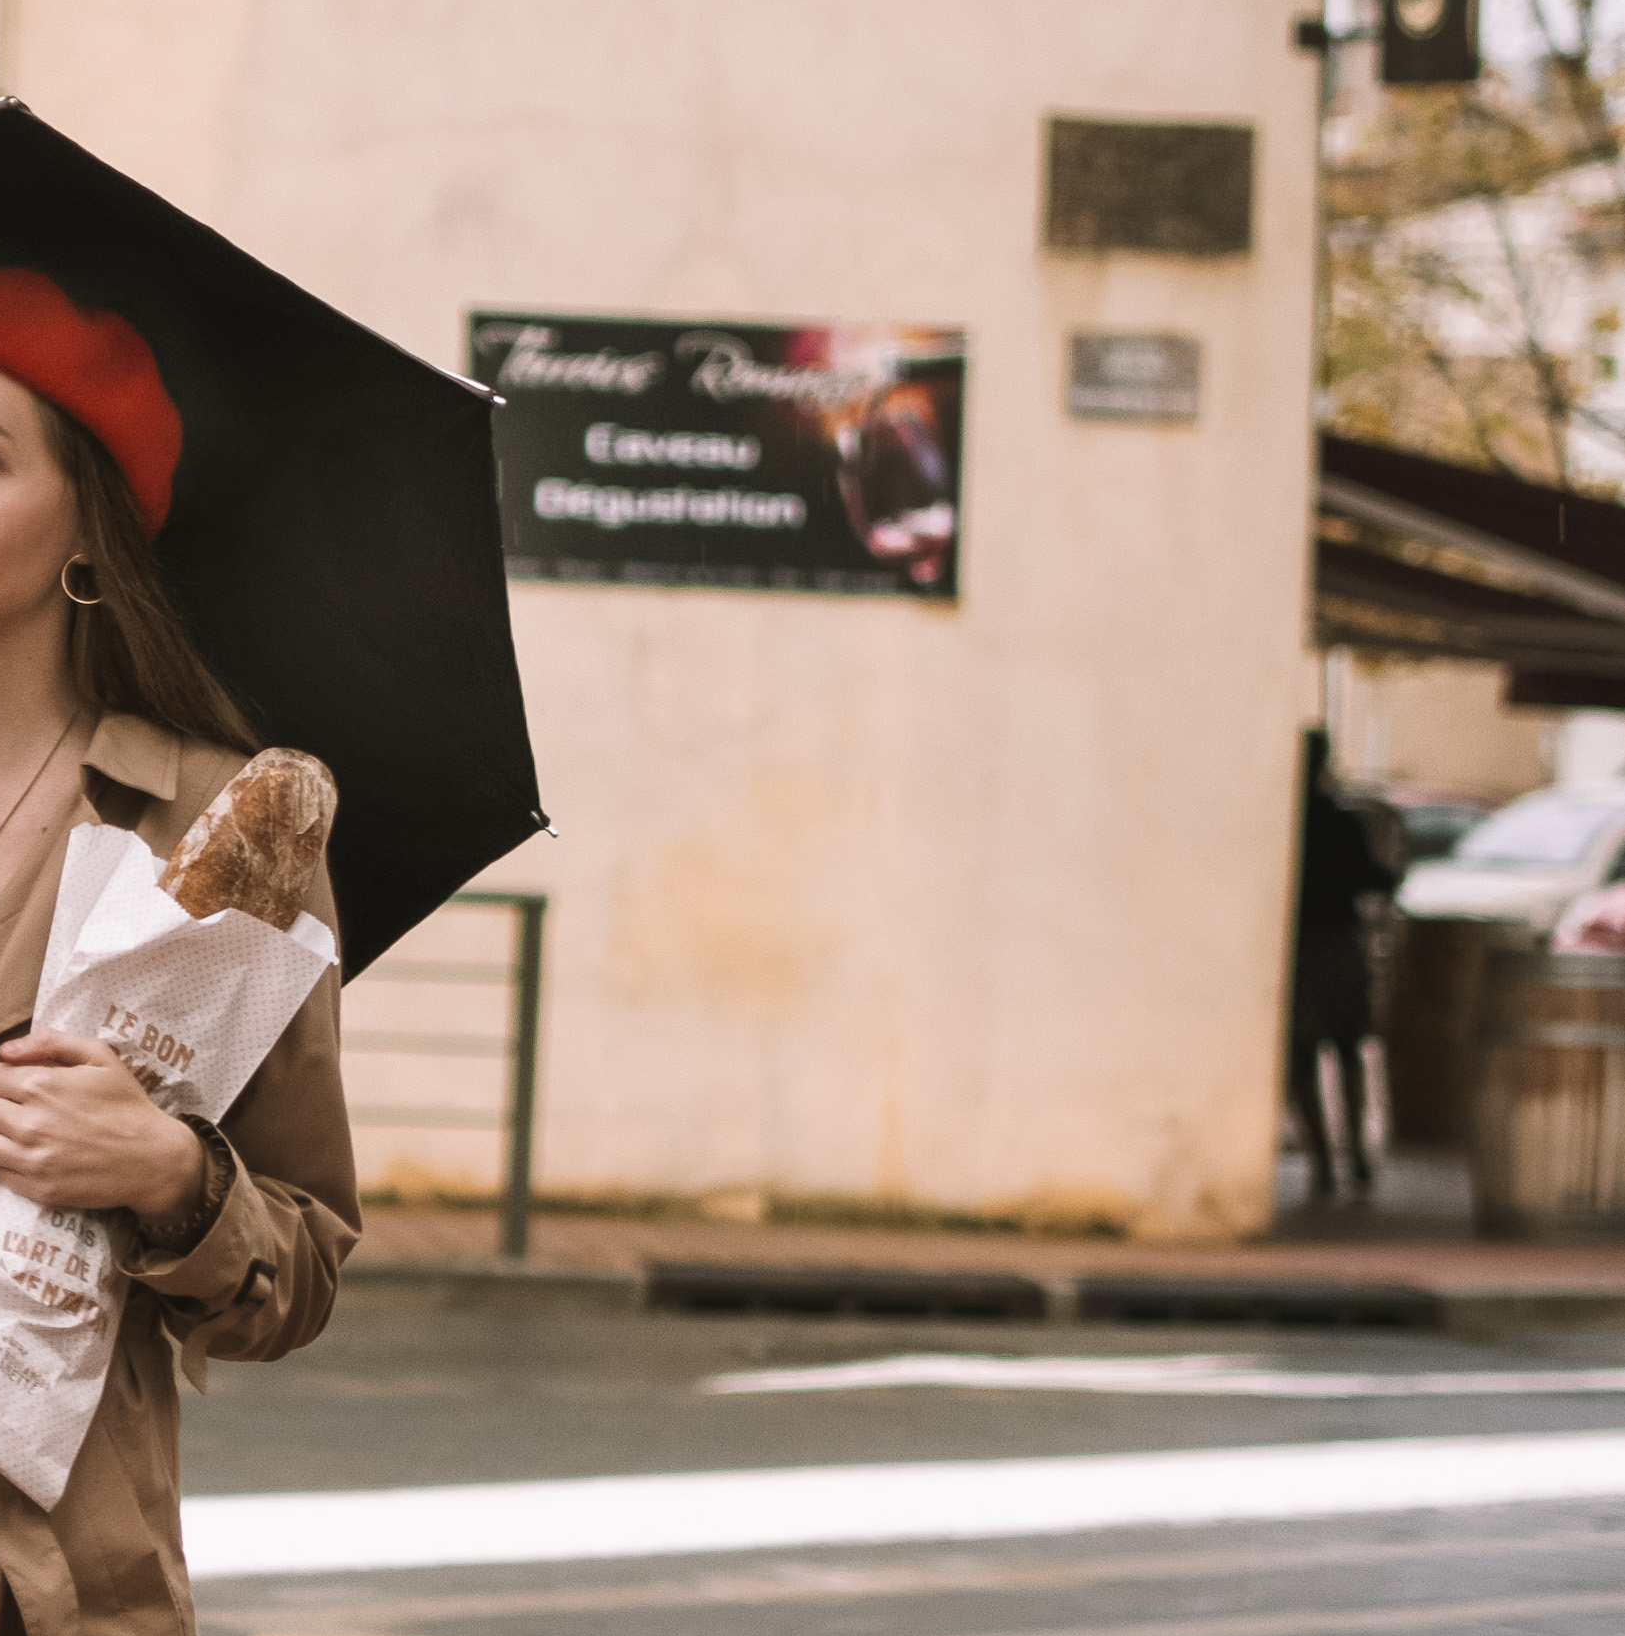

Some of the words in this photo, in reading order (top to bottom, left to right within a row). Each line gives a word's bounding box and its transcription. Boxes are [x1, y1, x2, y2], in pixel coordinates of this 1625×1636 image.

[102, 1004, 139, 1039] LE
[139, 1023, 196, 1074] BON
[2, 1230, 62, 1267] L'ART
[63, 1253, 91, 1283] DE
